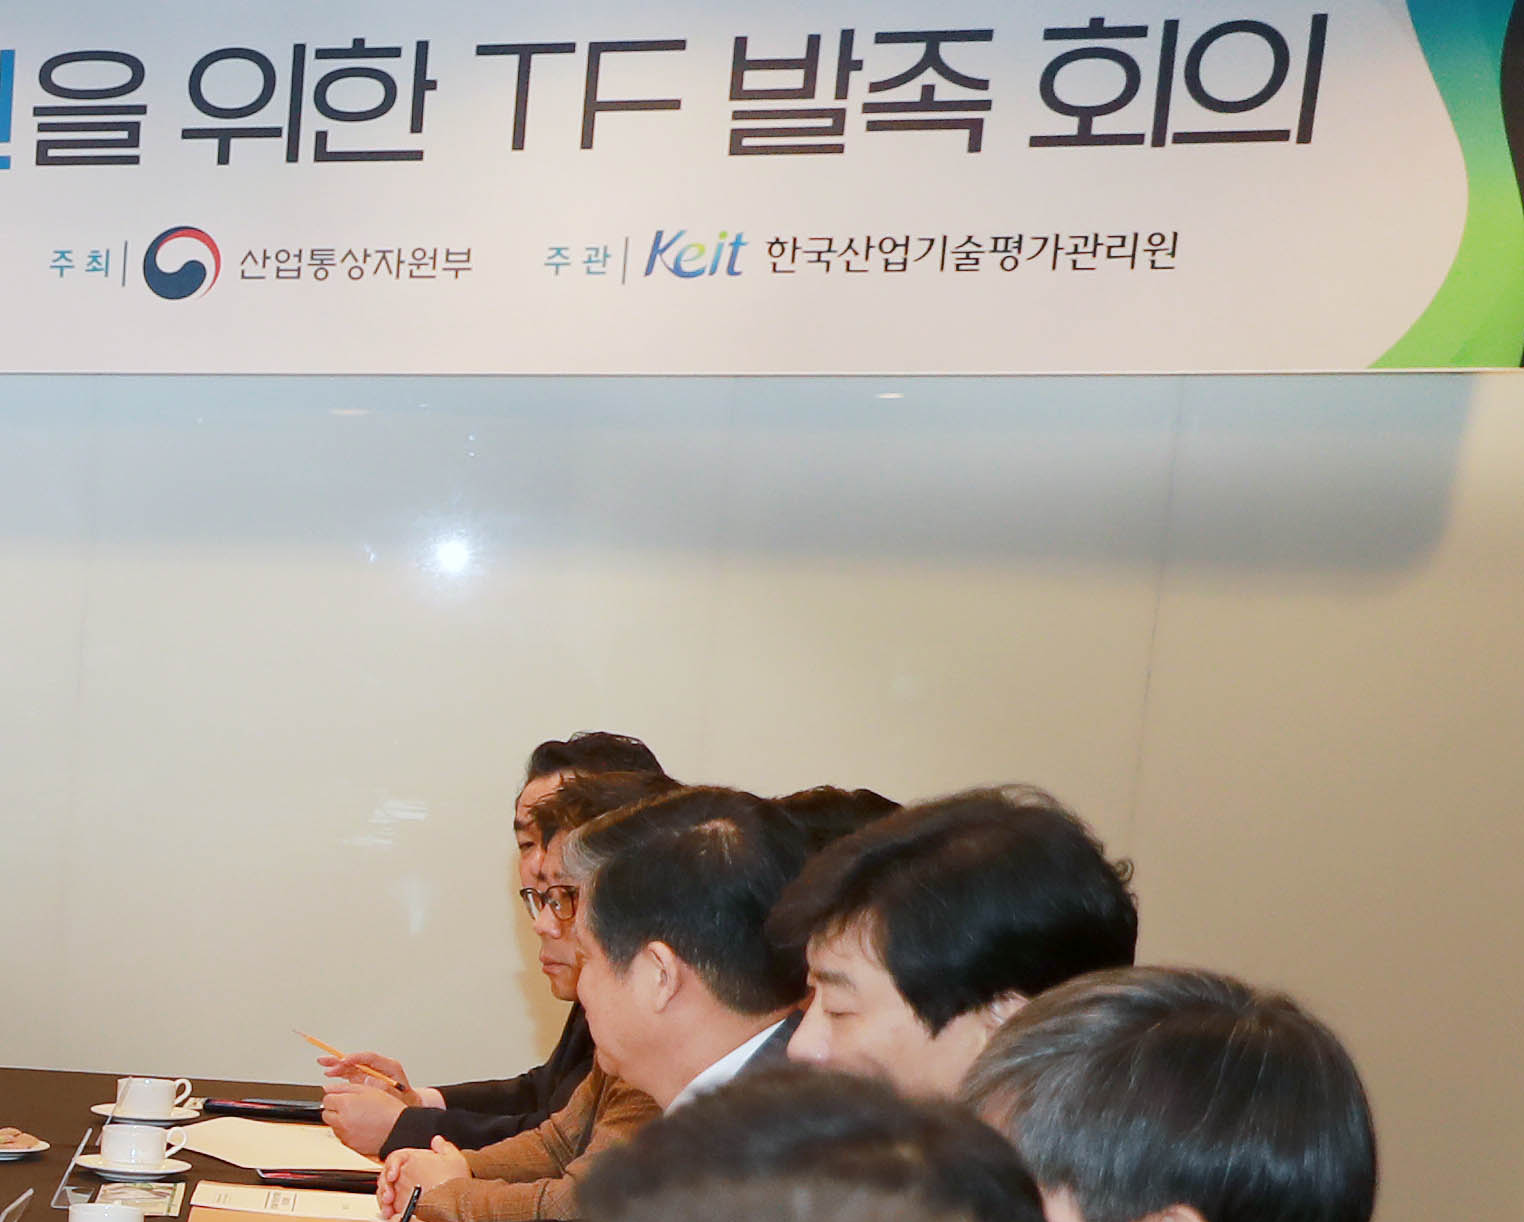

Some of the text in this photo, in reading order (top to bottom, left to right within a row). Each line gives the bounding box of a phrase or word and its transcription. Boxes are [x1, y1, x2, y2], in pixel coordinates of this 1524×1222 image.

[181, 37, 439, 167] 위한
[475, 38, 688, 153] TF
[727, 28, 995, 158] 발족
[1028, 12, 1330, 150] 회의
[238, 247, 474, 282] 산업통상자원부
[643, 229, 749, 280] Keit
[765, 230, 1180, 275] 한국산업기술평가관리원
